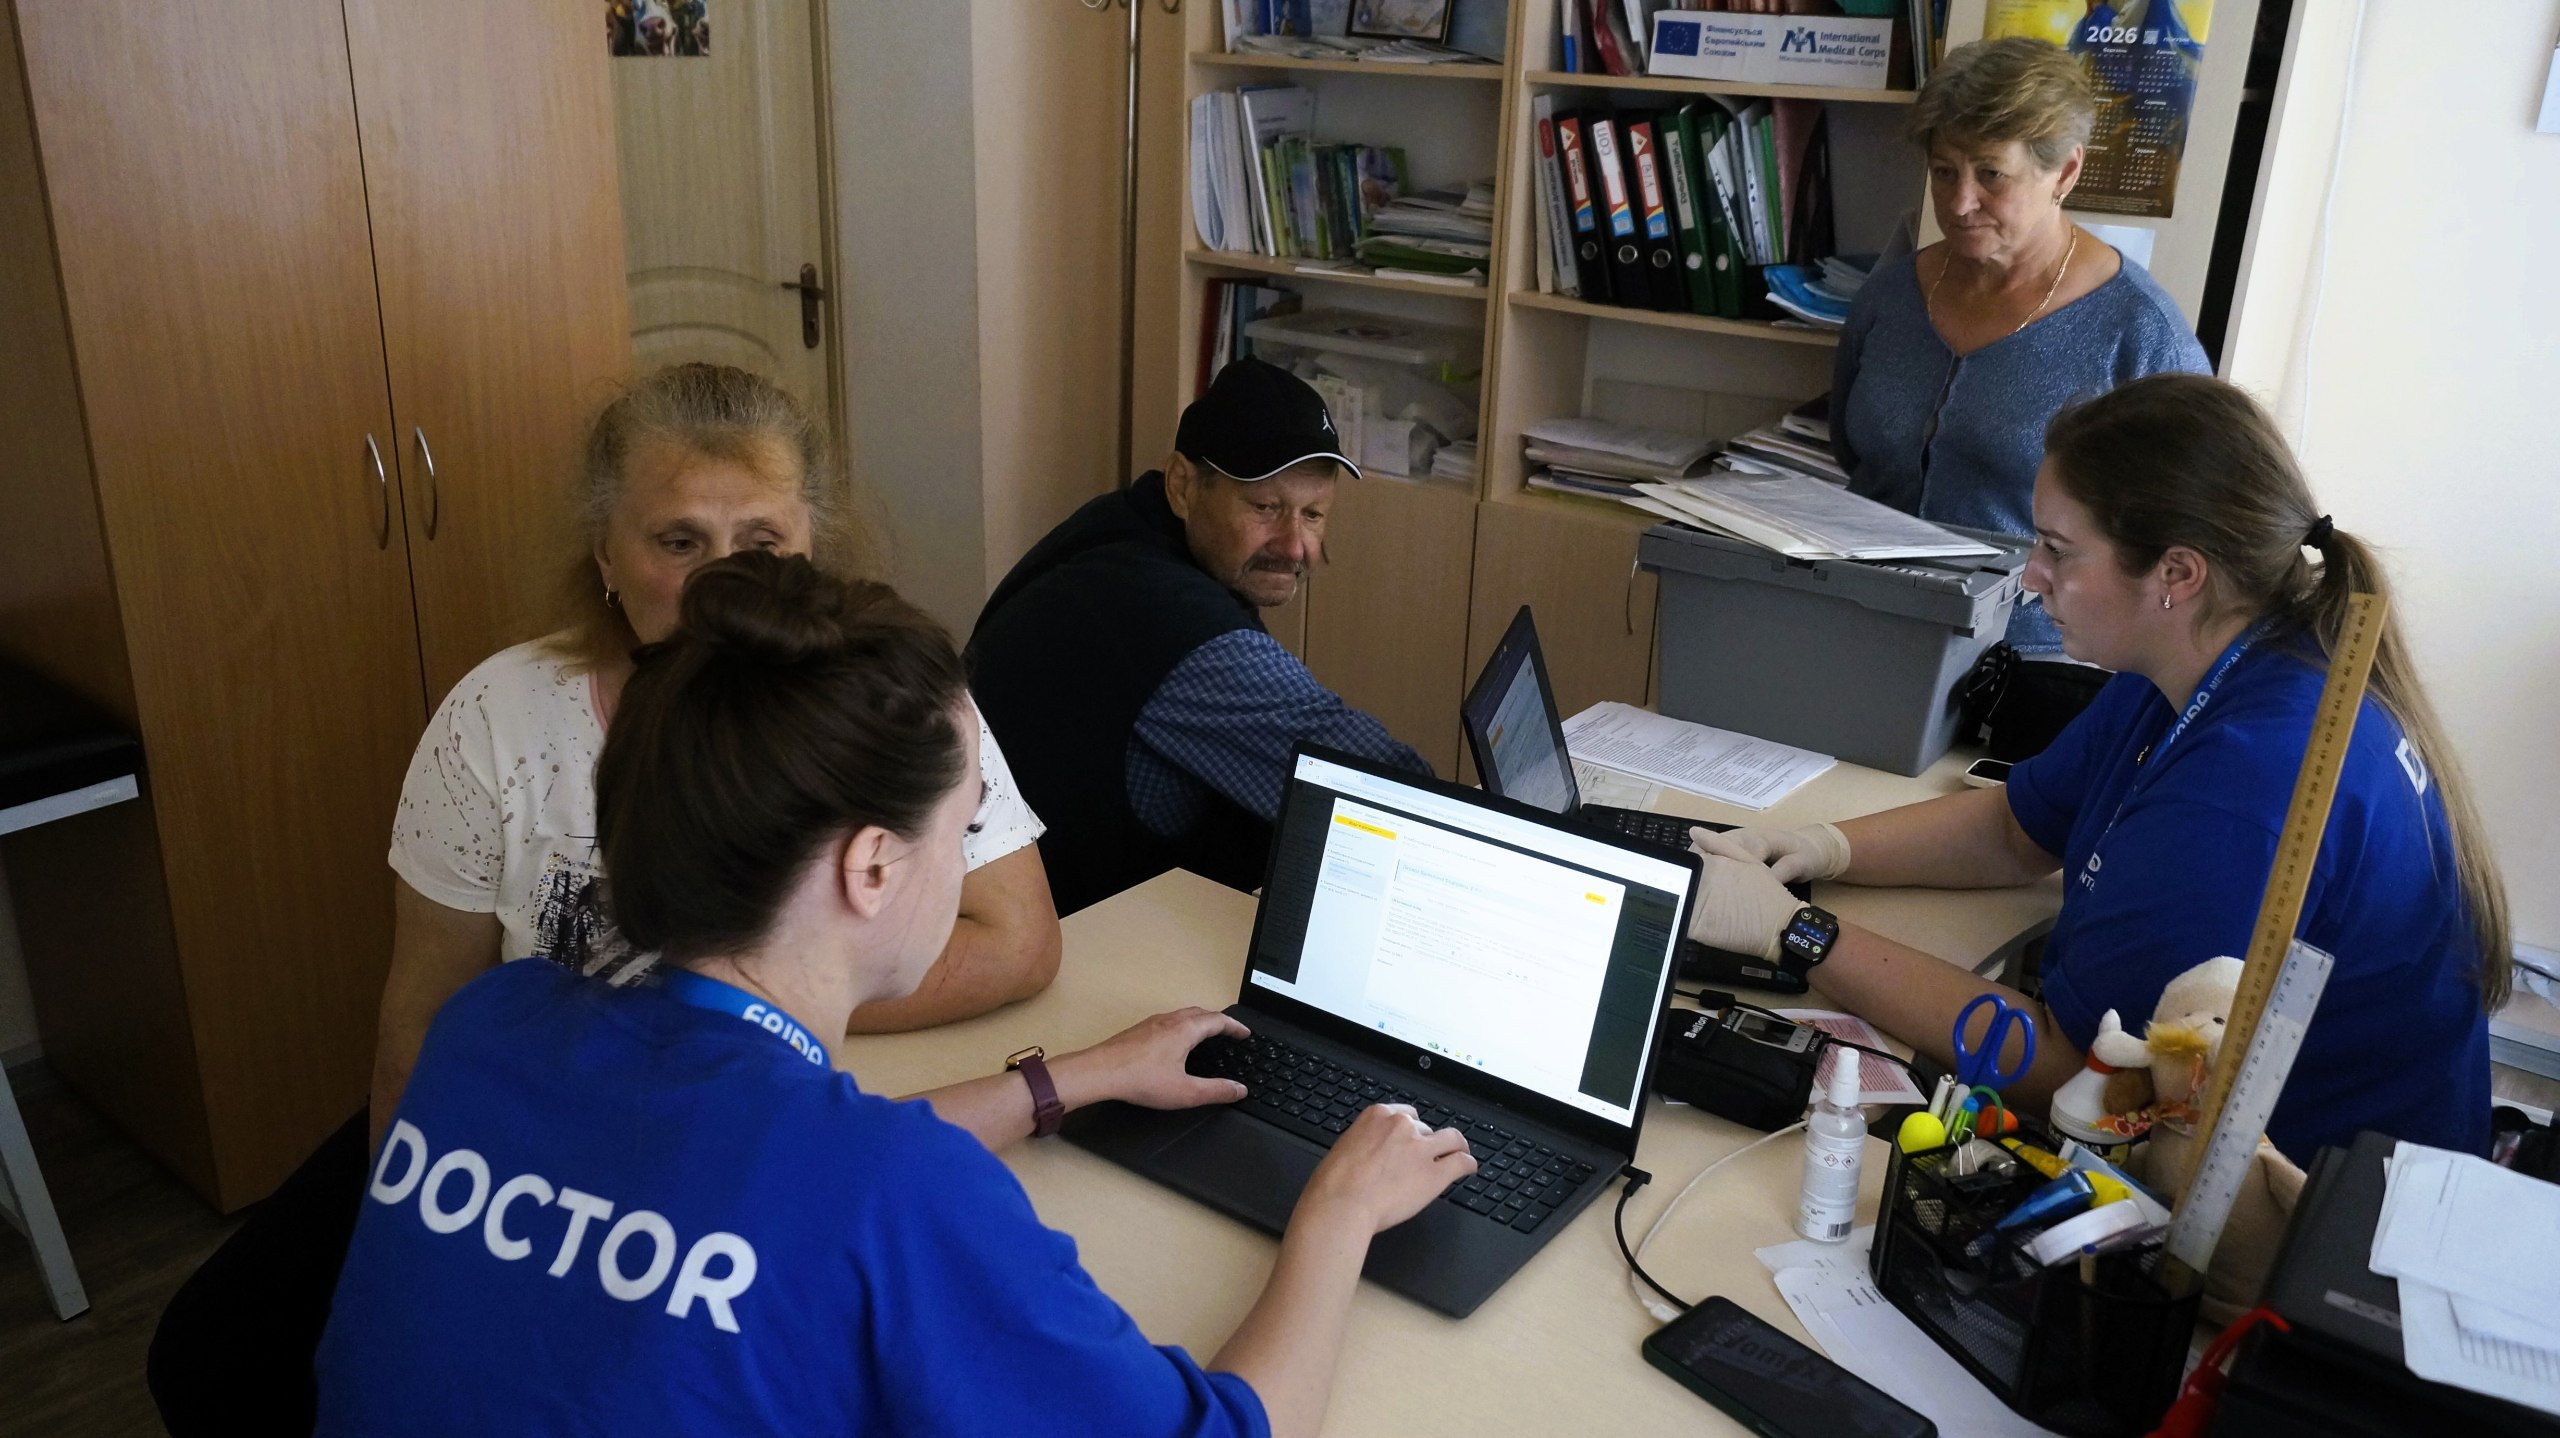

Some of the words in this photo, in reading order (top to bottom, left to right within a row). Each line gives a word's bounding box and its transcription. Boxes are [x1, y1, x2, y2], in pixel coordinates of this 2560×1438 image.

[1820, 31, 1881, 44] International
[2086, 26, 2139, 44] 2026
[1703, 47, 1737, 57] Союзом
[1818, 44, 1856, 55] Medical
[1858, 46, 1886, 58] Corps
[1788, 932, 1810, 949] 12:08
[369, 1118, 758, 1335] DOCTOR
